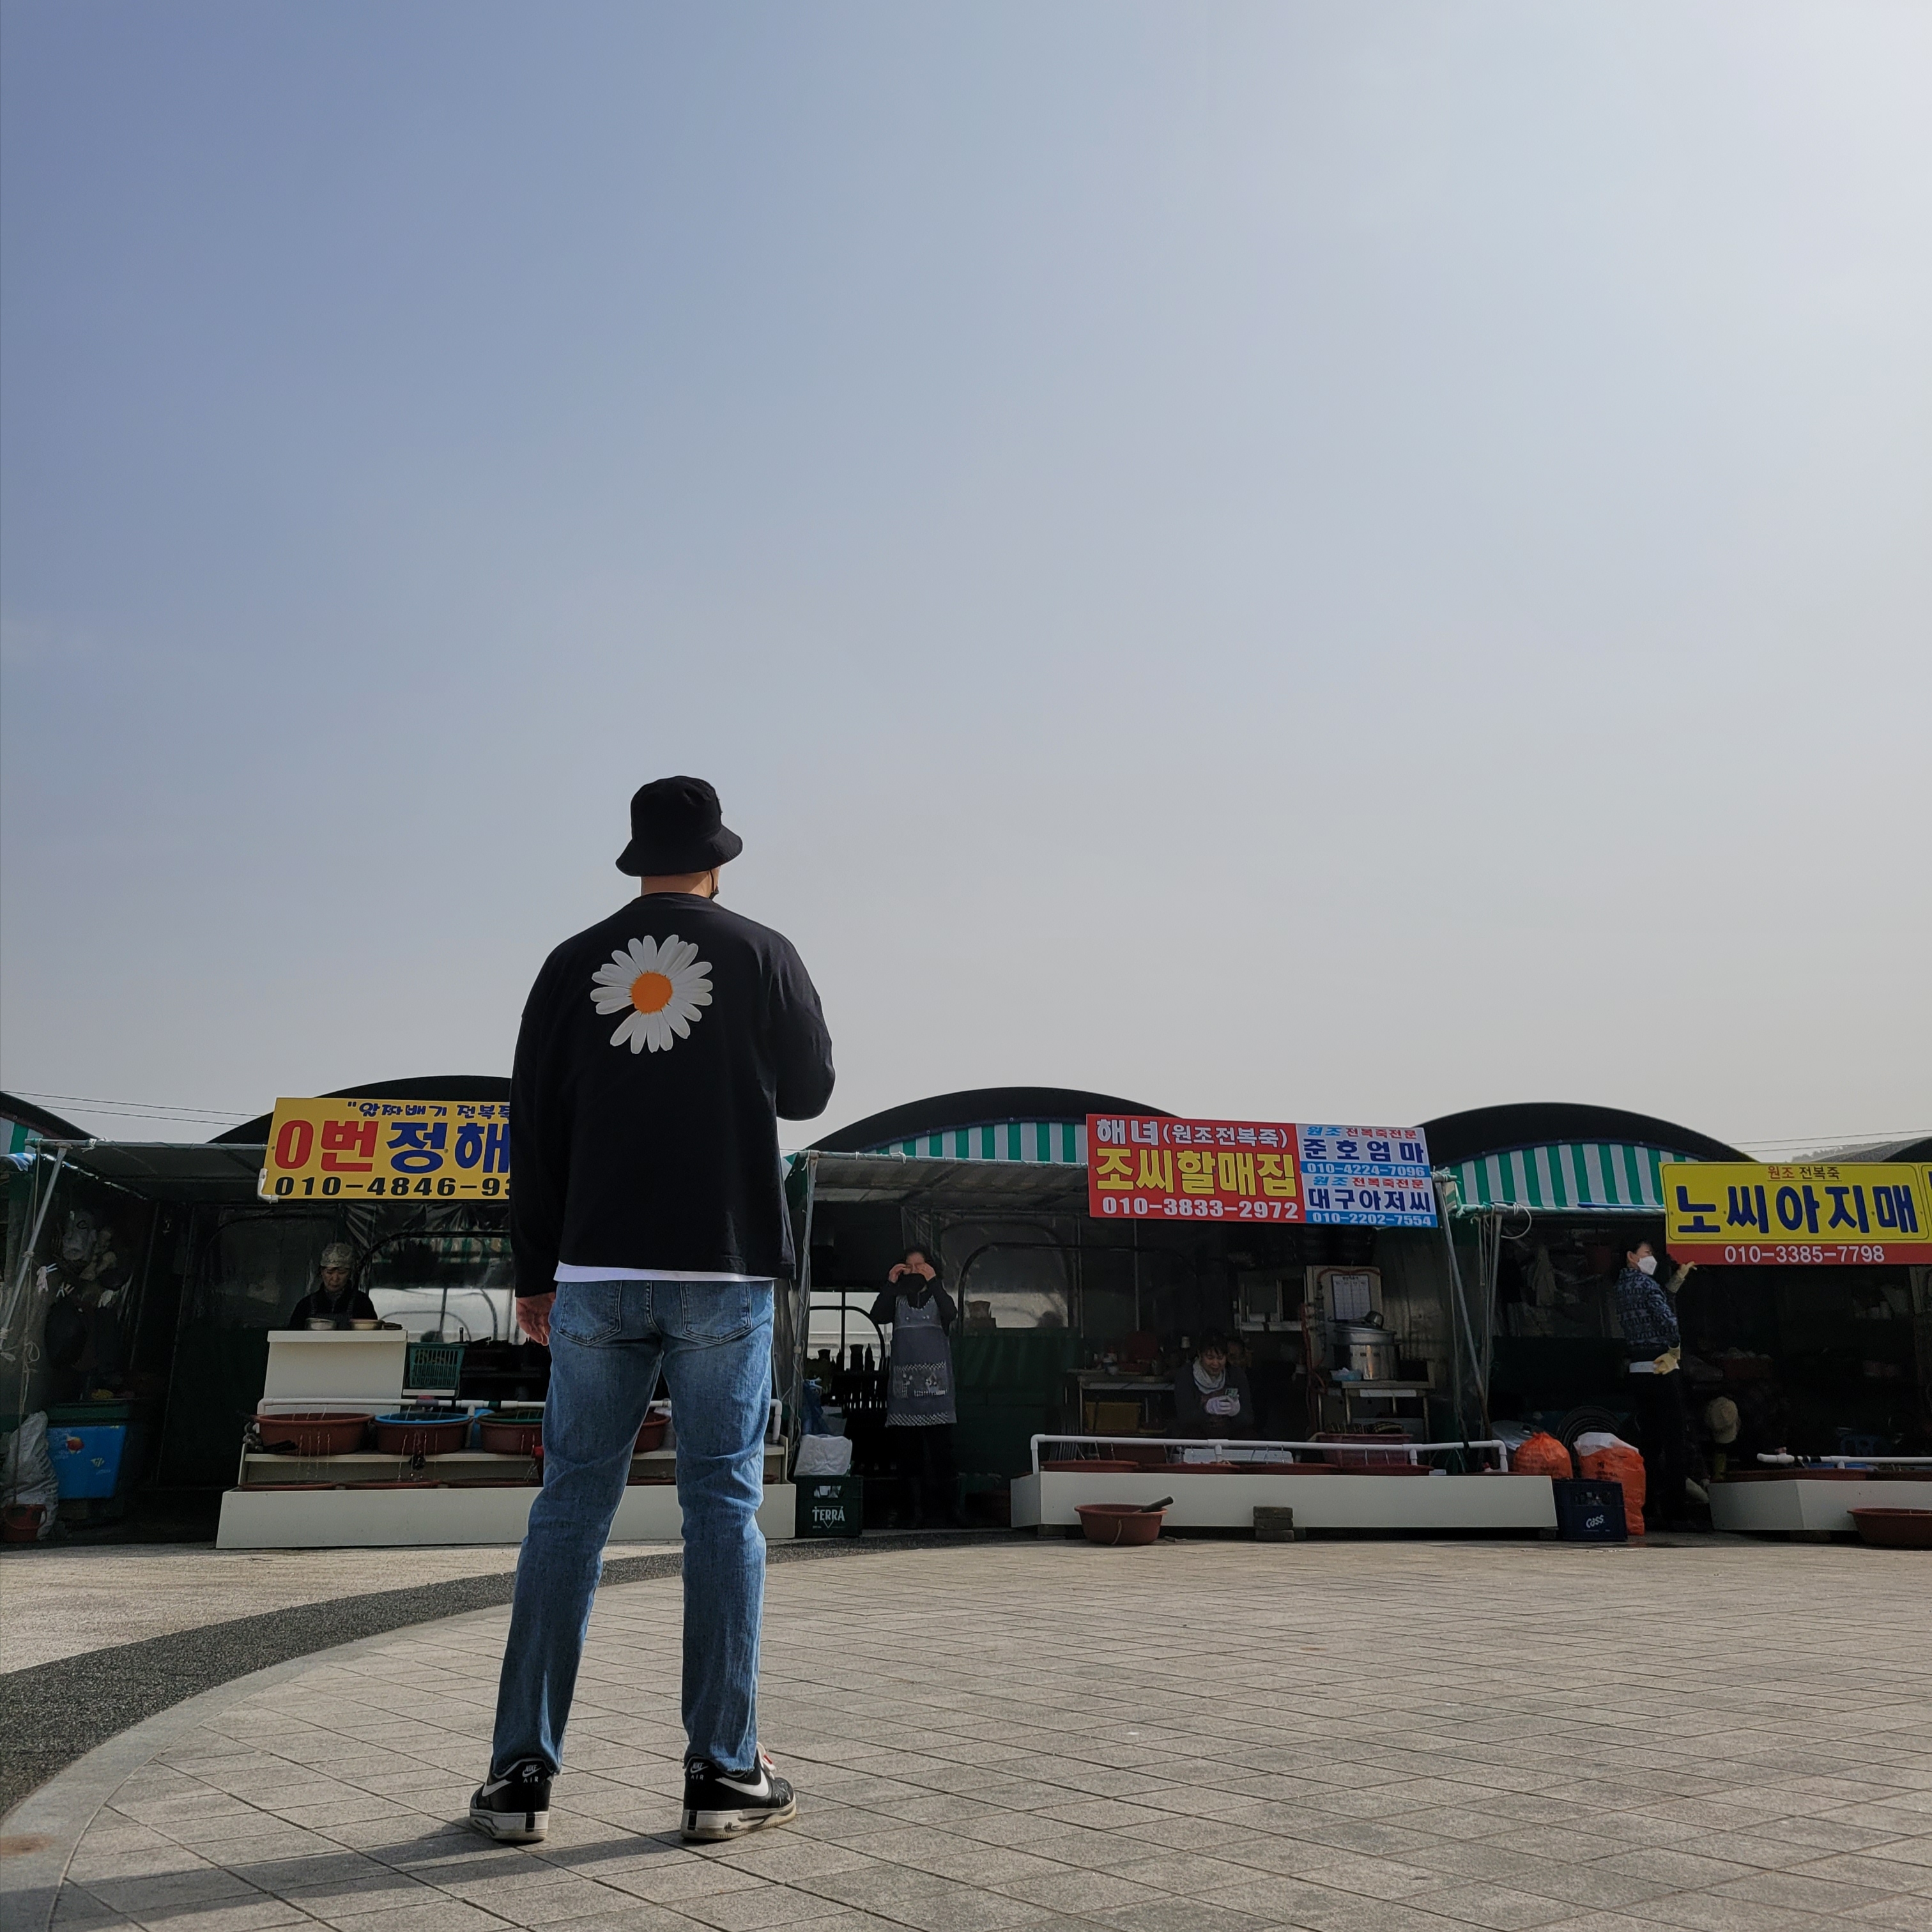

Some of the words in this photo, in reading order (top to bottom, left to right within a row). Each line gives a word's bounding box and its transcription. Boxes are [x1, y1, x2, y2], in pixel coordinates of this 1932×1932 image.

[1307, 1126, 1342, 1137] 원조
[1096, 1147, 1296, 1198] 조씨할매집
[1307, 1163, 1425, 1176] 010-4224-7096
[1768, 1165, 1795, 1179] 원조
[1798, 1166, 1841, 1180] 전복죽
[1313, 1176, 1348, 1186] 원조
[1103, 1197, 1298, 1220] 010-3833-2972
[1676, 1184, 1919, 1234] 노씨아지매
[1312, 1212, 1432, 1226] 010-2202-7554
[1725, 1245, 1885, 1263] 010-3385-7798
[812, 1506, 845, 1522] TERRA
